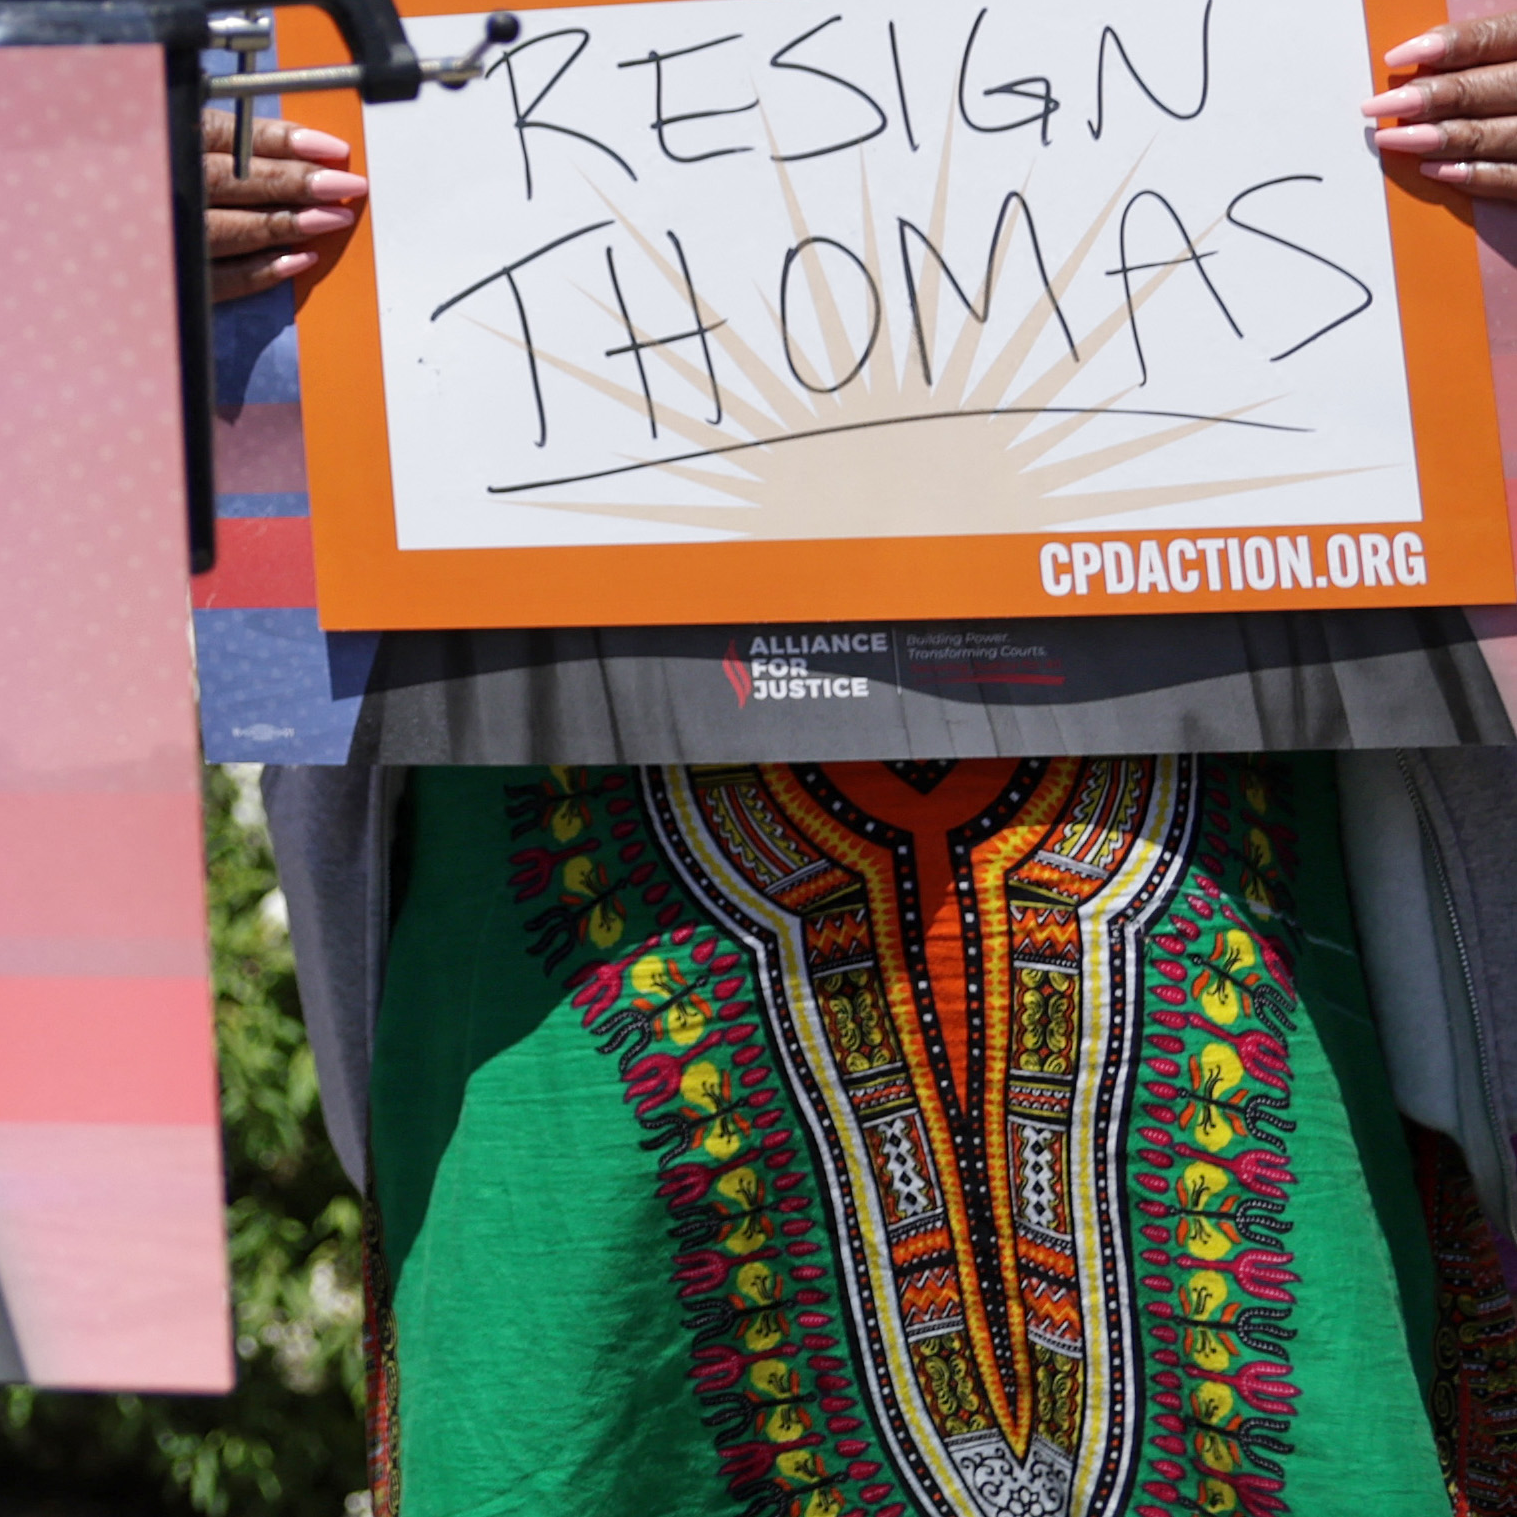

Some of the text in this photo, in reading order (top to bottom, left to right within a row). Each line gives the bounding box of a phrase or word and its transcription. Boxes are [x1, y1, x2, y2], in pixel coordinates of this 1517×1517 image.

[429, 174, 1373, 449] THOMAS
[1038, 530, 1429, 598] CPDACTION.ORG
[748, 632, 889, 656] ALLIANCE
[751, 657, 809, 678] FOR
[752, 677, 870, 701] JUSTICE
